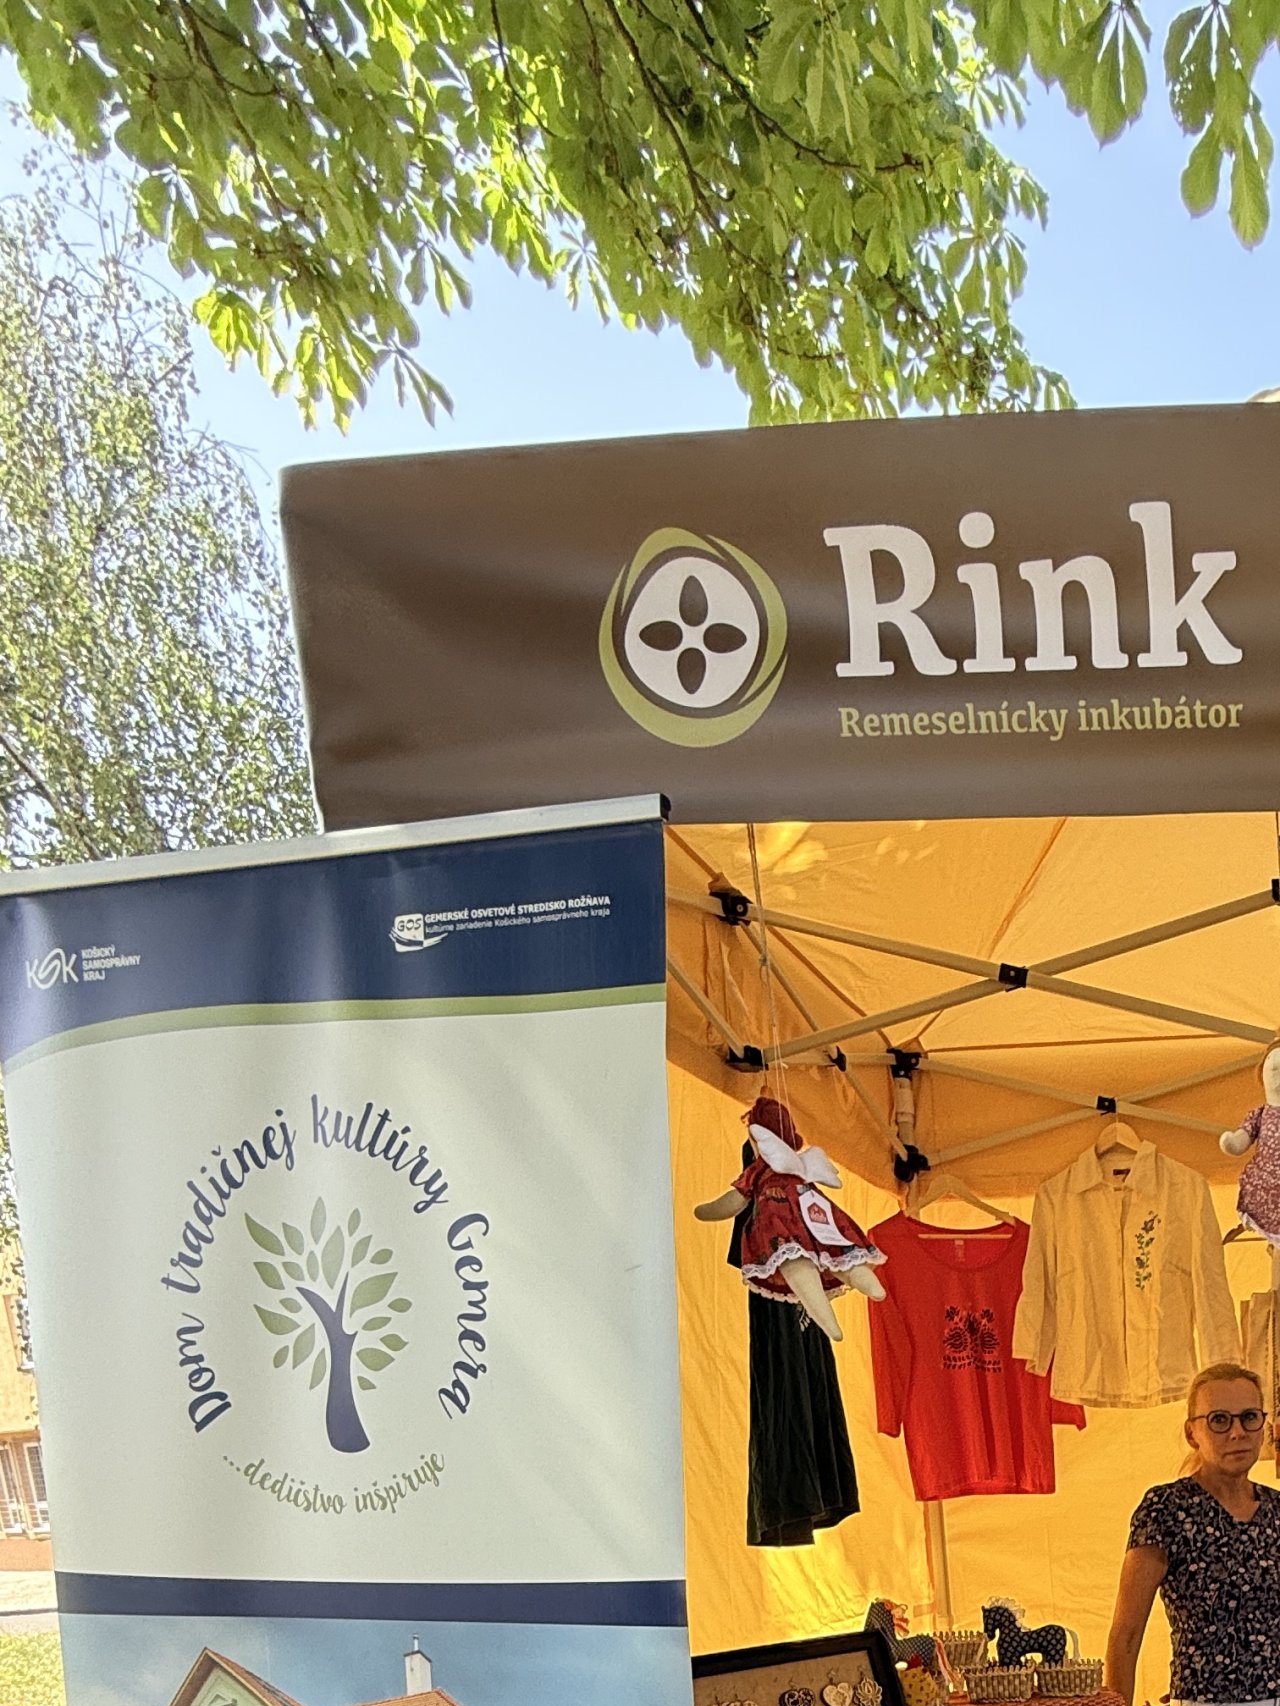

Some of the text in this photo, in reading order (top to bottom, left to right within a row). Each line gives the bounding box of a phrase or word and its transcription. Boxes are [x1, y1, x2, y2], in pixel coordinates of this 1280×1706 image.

[823, 500, 1243, 678] Rink
[838, 695, 1244, 741] Remeselnícky inkubátor
[425, 895, 611, 923] GEMERSKÉ OSVETOVÉ STREDISKO ROŽŇAVA
[494, 916, 531, 928] Košického
[590, 908, 611, 918] kraja
[397, 918, 422, 932] GOS
[81, 944, 115, 960] KOŠICKÝ
[82, 955, 141, 971] SAMOSPRÁVNY
[26, 947, 80, 990] KSK
[83, 970, 106, 982] KRAJ
[161, 1093, 490, 1433] Dom tradičnej kultúry Gemera
[353, 1452, 445, 1514] inšpiruje
